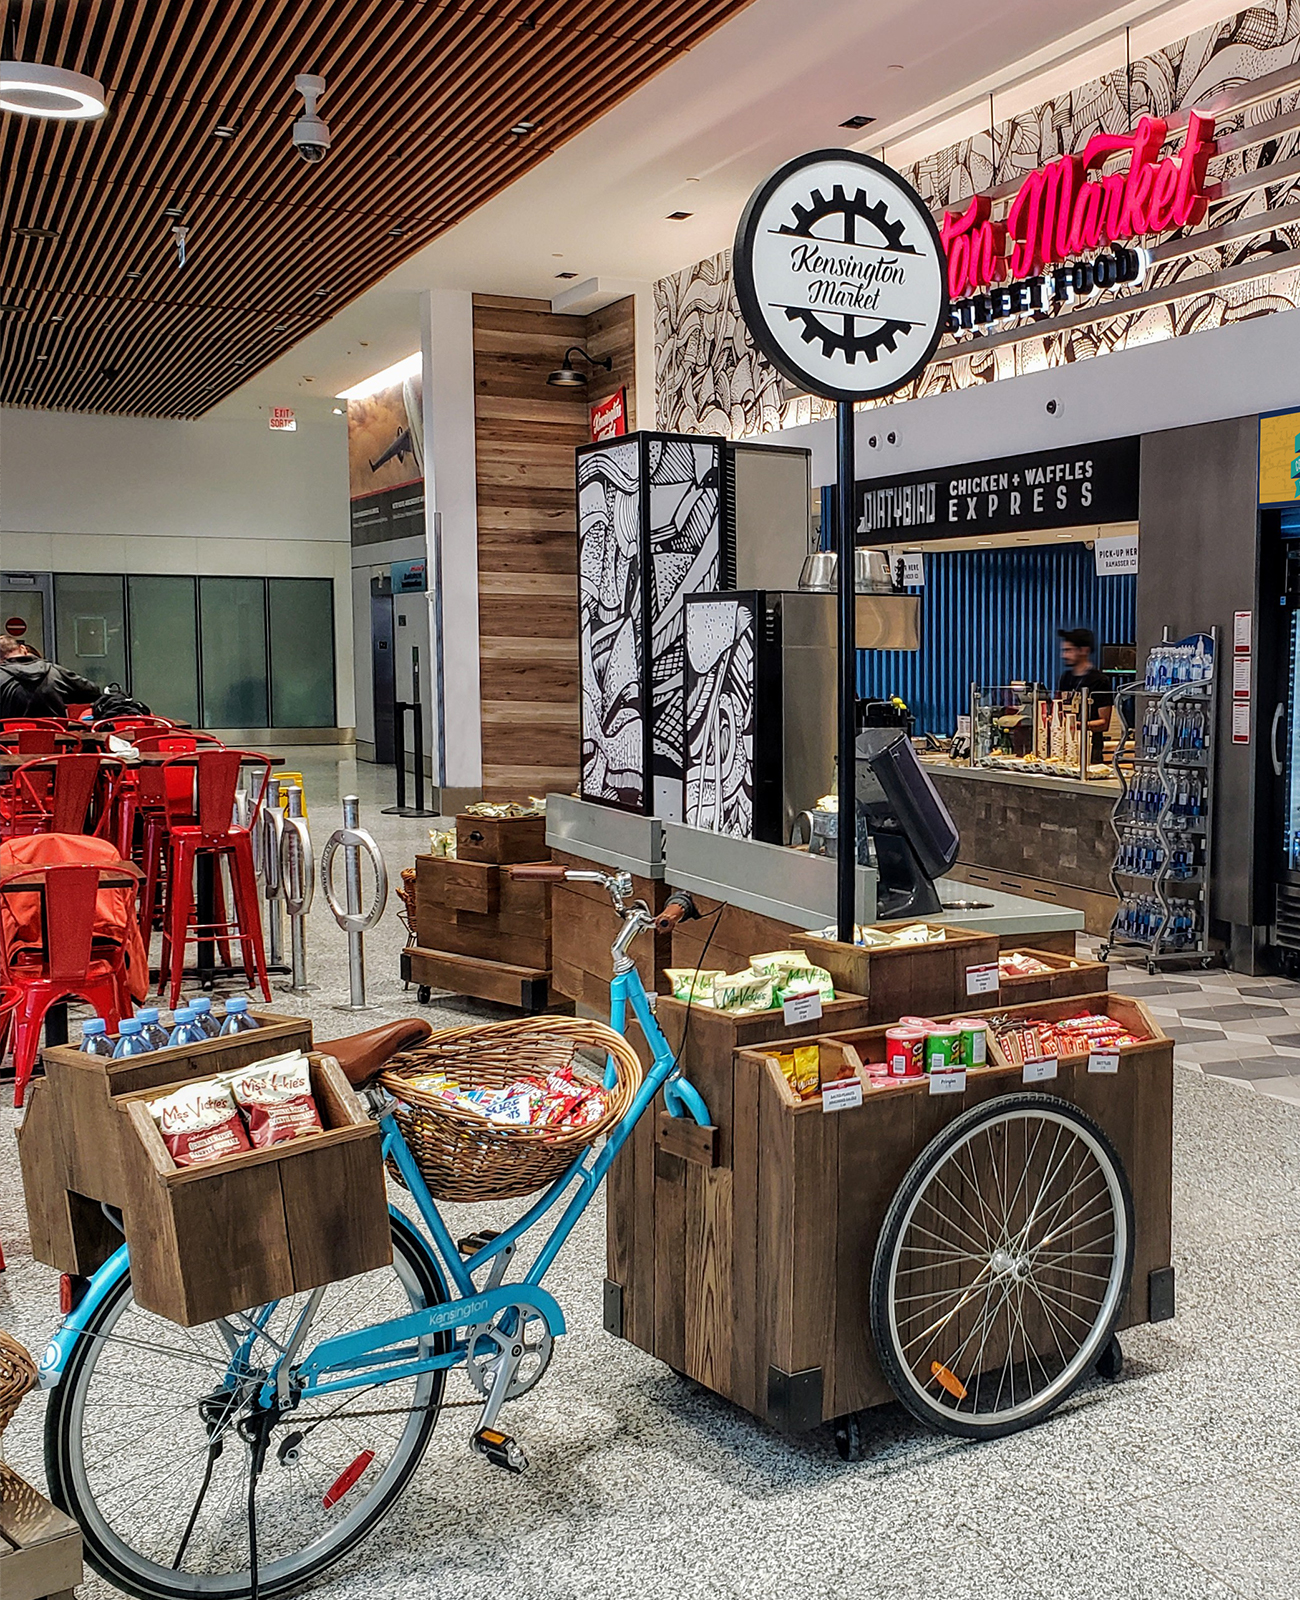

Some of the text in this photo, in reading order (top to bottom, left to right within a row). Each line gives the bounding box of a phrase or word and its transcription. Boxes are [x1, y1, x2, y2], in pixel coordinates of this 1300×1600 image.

[1007, 109, 1206, 279] Market
[791, 244, 905, 290] Kensington
[1055, 245, 1140, 301] FOOD
[808, 279, 881, 311] Market
[274, 408, 290, 418] EXIT
[949, 472, 1009, 497] CHICKEN
[1024, 460, 1094, 486] WAFFLES
[948, 481, 1093, 522] EXPRESS
[1099, 548, 1124, 559] PICK-UP
[161, 1096, 228, 1130] Miss Vickie's
[429, 1299, 489, 1327] Kensington
